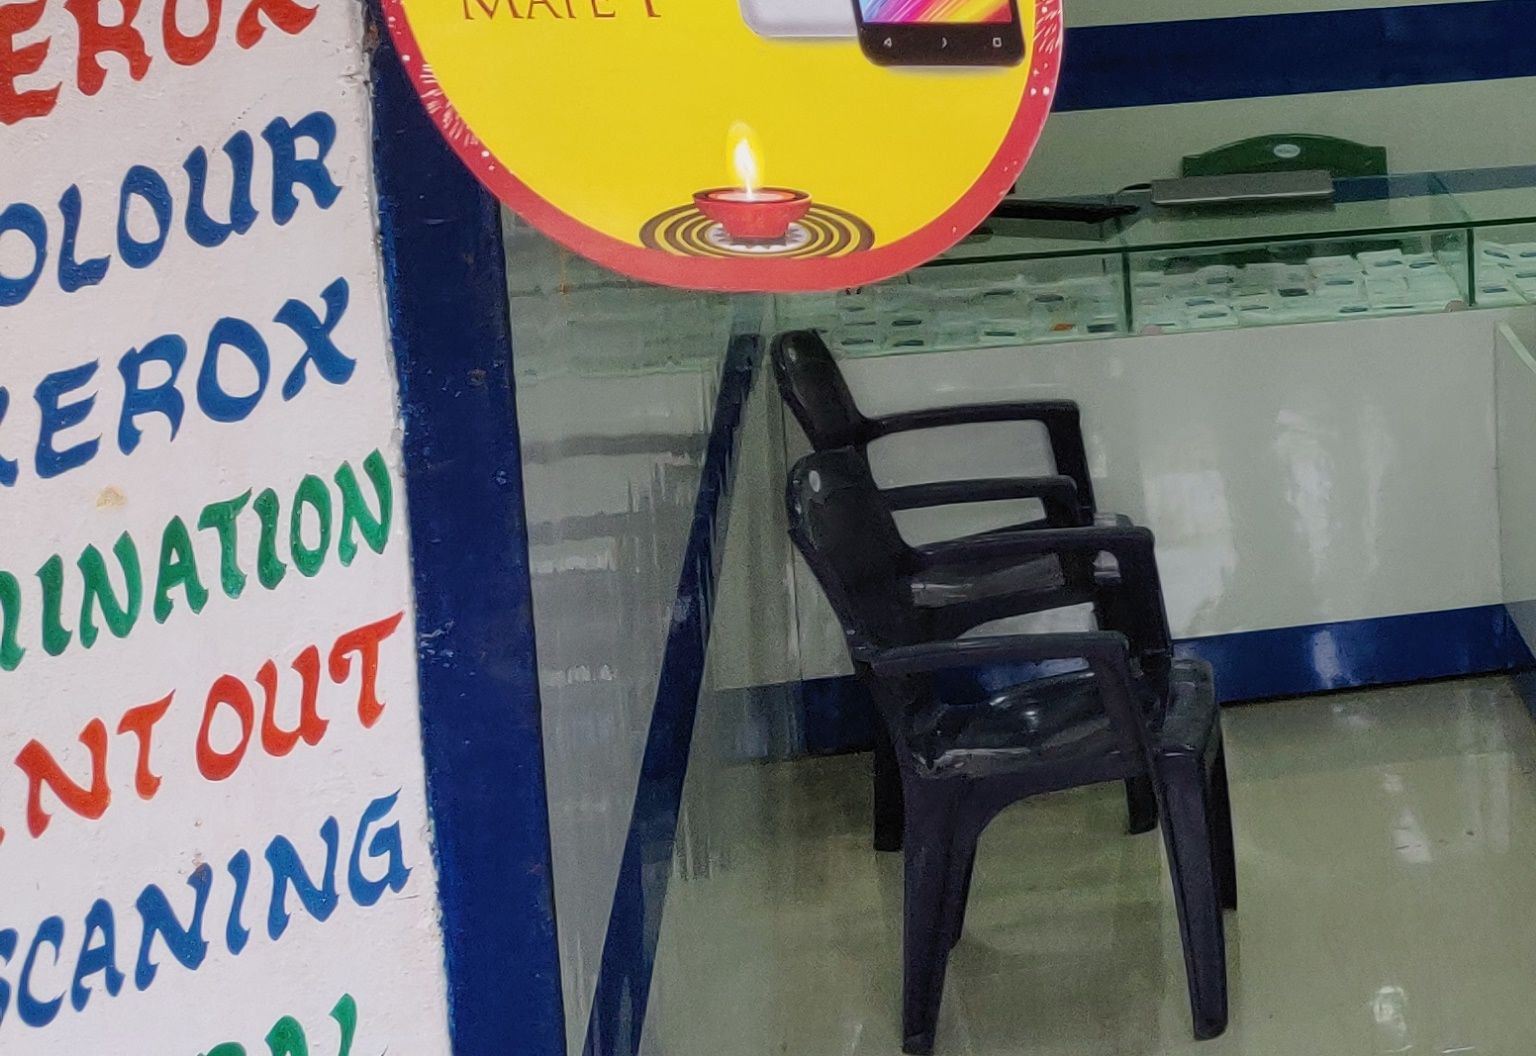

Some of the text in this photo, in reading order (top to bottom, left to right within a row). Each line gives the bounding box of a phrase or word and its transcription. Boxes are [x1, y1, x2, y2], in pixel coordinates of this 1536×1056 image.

[0, 277, 357, 487] EROX
[0, 611, 405, 840] NT OUT
